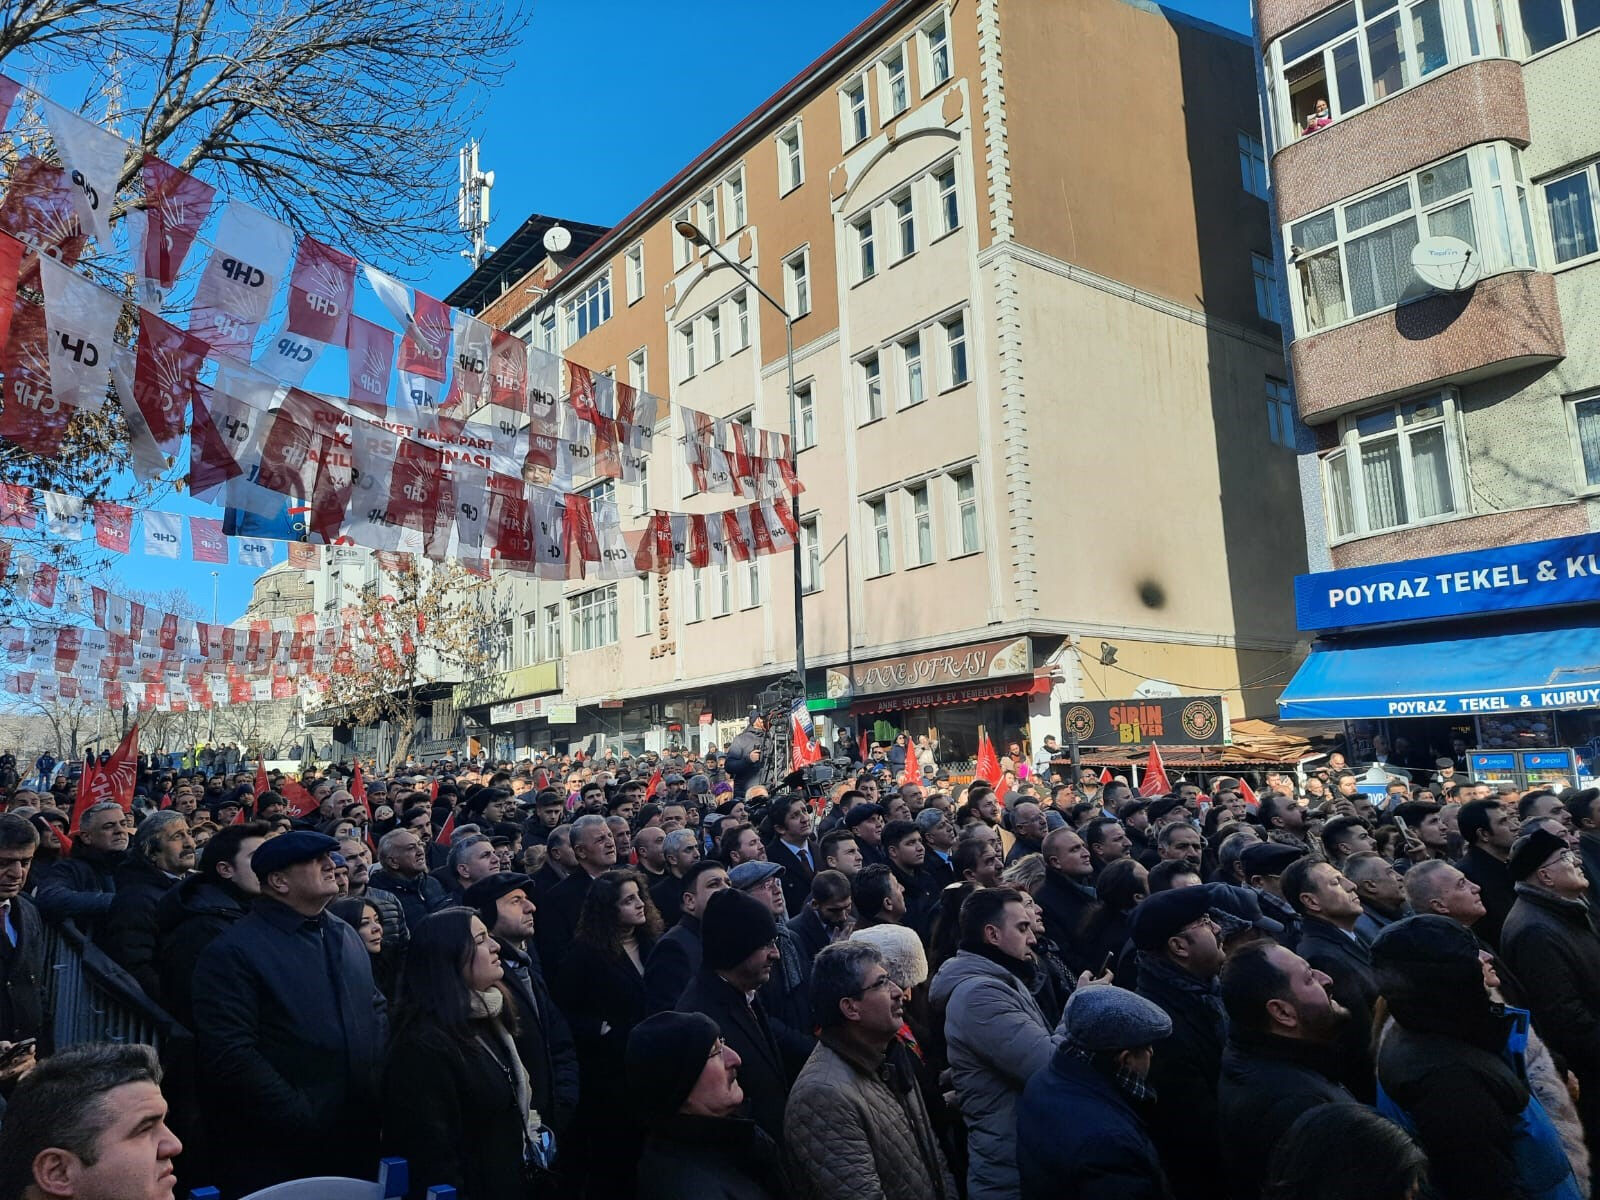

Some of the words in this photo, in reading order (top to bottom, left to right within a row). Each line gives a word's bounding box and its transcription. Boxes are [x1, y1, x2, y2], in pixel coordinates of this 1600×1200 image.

[243, 544, 267, 553] CHP
[336, 549, 358, 557] CHP
[1328, 577, 1430, 608] POYRAZ
[1436, 564, 1528, 594] TEKEL
[1536, 560, 1558, 582] &
[856, 663, 907, 688] ANNE
[907, 651, 988, 684] SOFRASI
[902, 697, 934, 707] SOFRASI
[1389, 700, 1446, 714] POYRAZ
[1459, 697, 1509, 711] TEKEL
[1520, 694, 1531, 707] &
[1109, 702, 1163, 731] ŞİRİN
[1119, 718, 1141, 744] Bİ
[1141, 724, 1164, 736] YER
